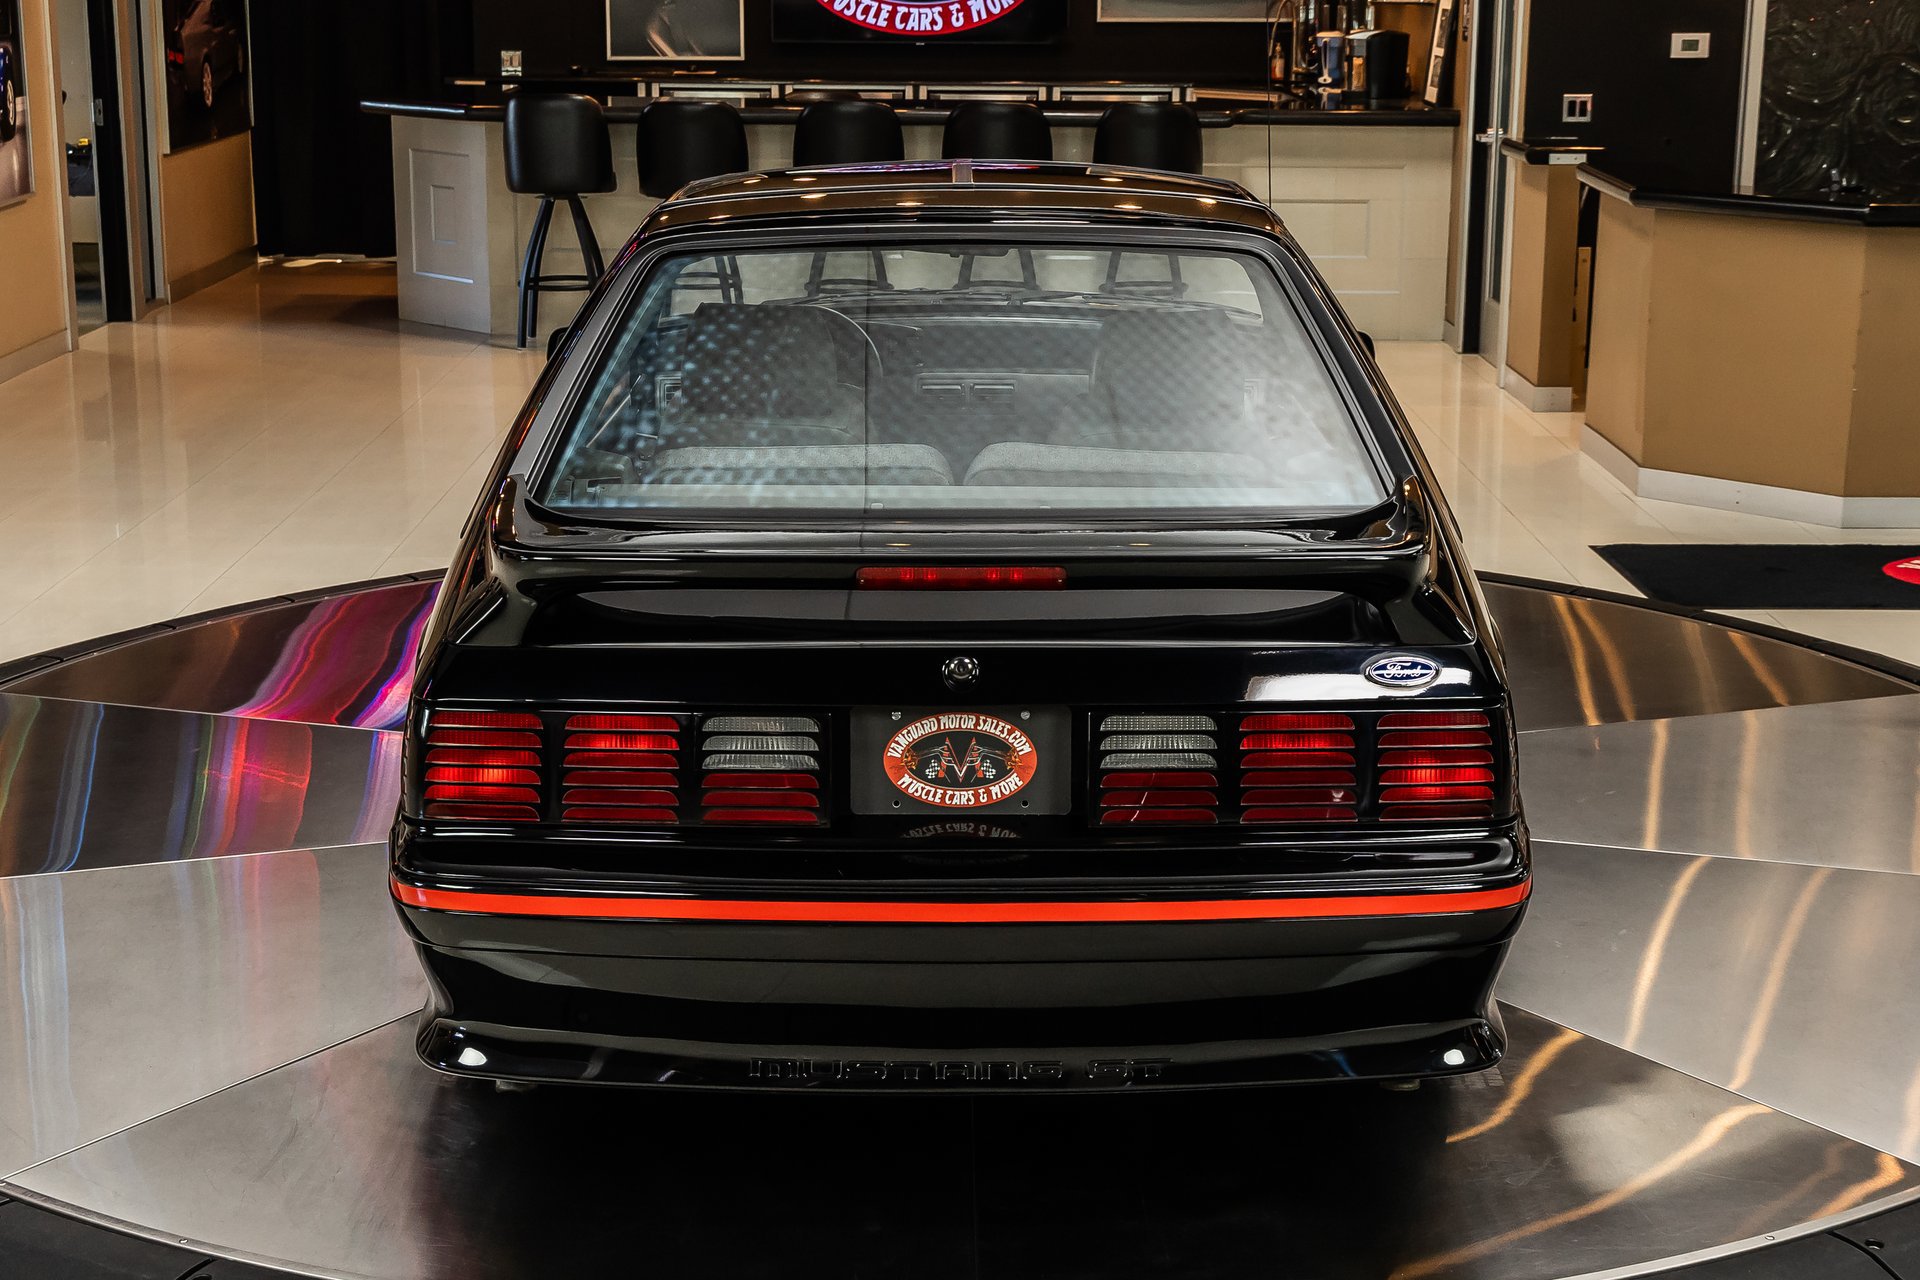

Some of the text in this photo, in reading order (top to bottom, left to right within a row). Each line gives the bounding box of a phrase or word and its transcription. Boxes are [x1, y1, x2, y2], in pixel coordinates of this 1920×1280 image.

[823, 0, 893, 27] USCLE
[895, 6, 943, 31] CARS
[949, 4, 964, 28] &
[1384, 662, 1422, 678] Ford
[887, 714, 1032, 758] VANGUARD MOTOR SALES.COM
[897, 772, 1024, 805] MUSCLE CARS & MORE
[749, 1056, 1174, 1080] MUSTANG GT
